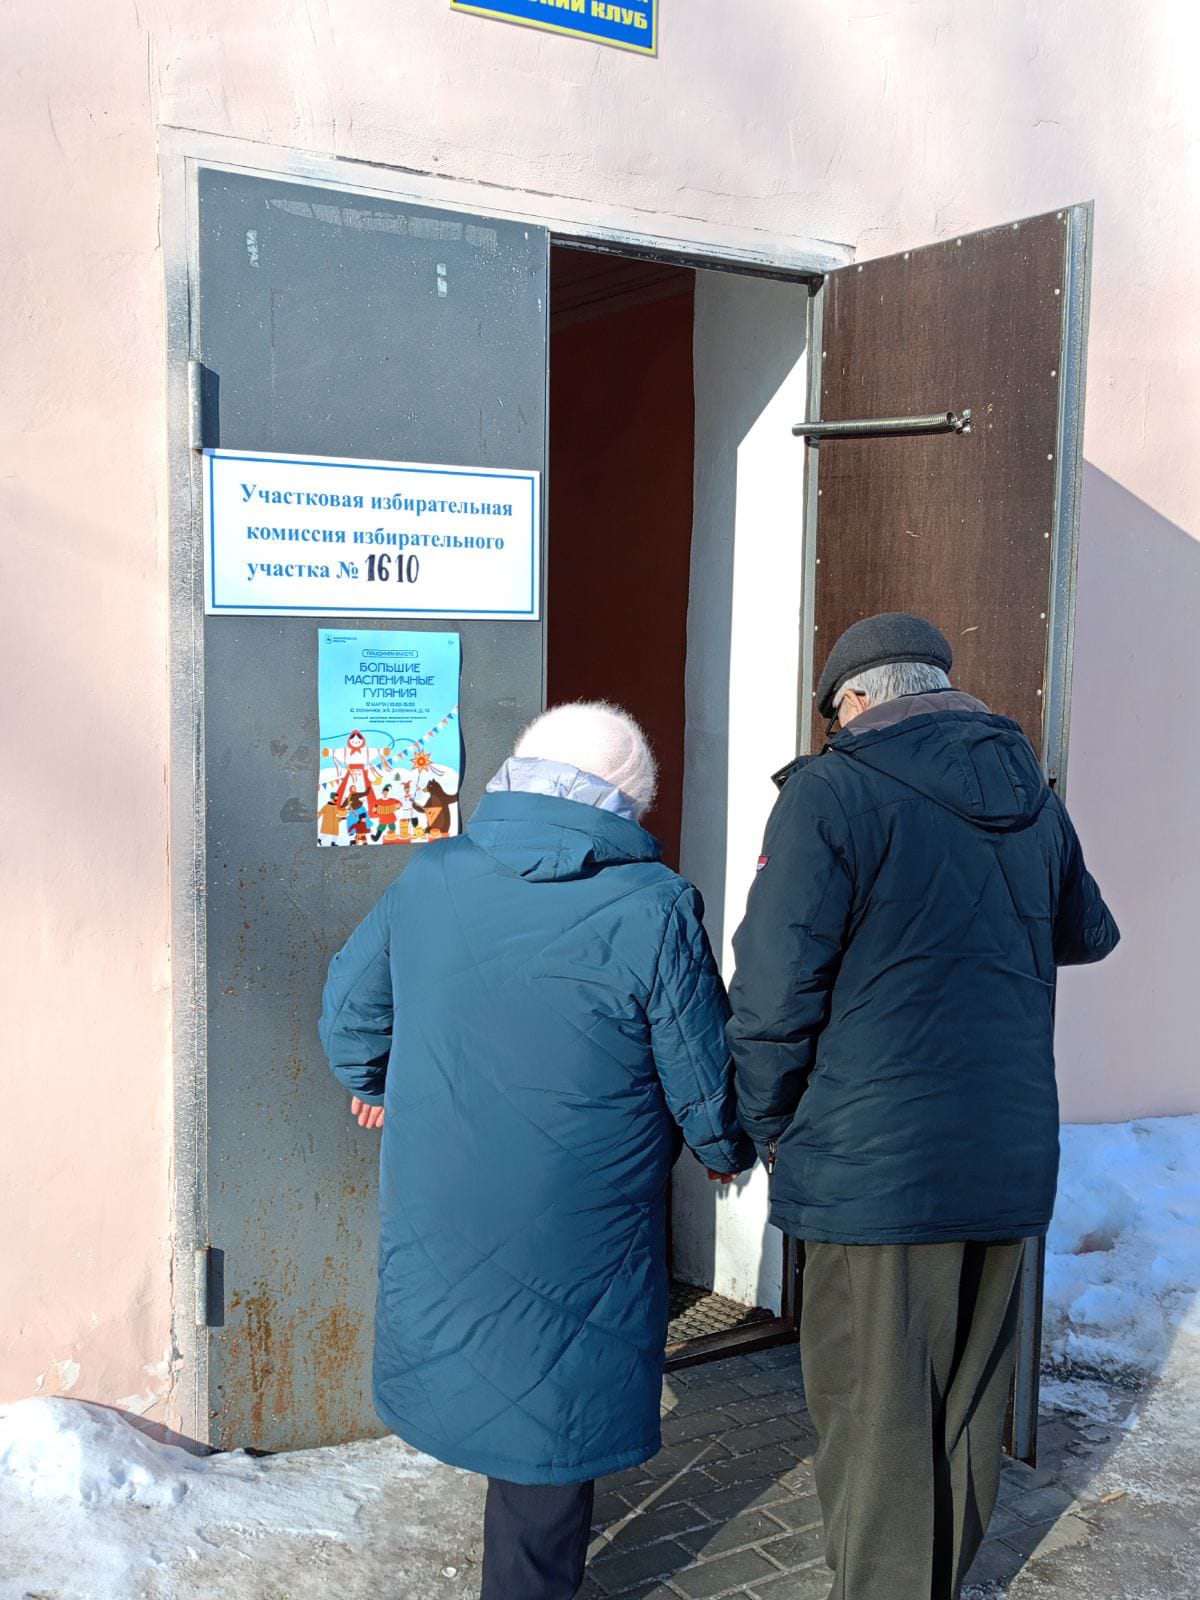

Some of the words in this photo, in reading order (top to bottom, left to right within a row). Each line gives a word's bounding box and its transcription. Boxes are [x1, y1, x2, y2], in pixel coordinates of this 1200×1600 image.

[591, 1, 648, 29] КЛУБ
[240, 484, 363, 508] Участковая
[372, 493, 512, 516] избирательная
[247, 527, 345, 543] комиссия
[353, 528, 504, 550] избирательного
[248, 563, 330, 581] участка
[336, 561, 358, 579] №
[365, 554, 419, 583] 1610
[360, 663, 420, 672] БОЛЬШИЕ
[345, 675, 434, 685] МАСЛЕНИЧНЫЕ
[363, 688, 416, 698] ГУЛЯНИЯ
